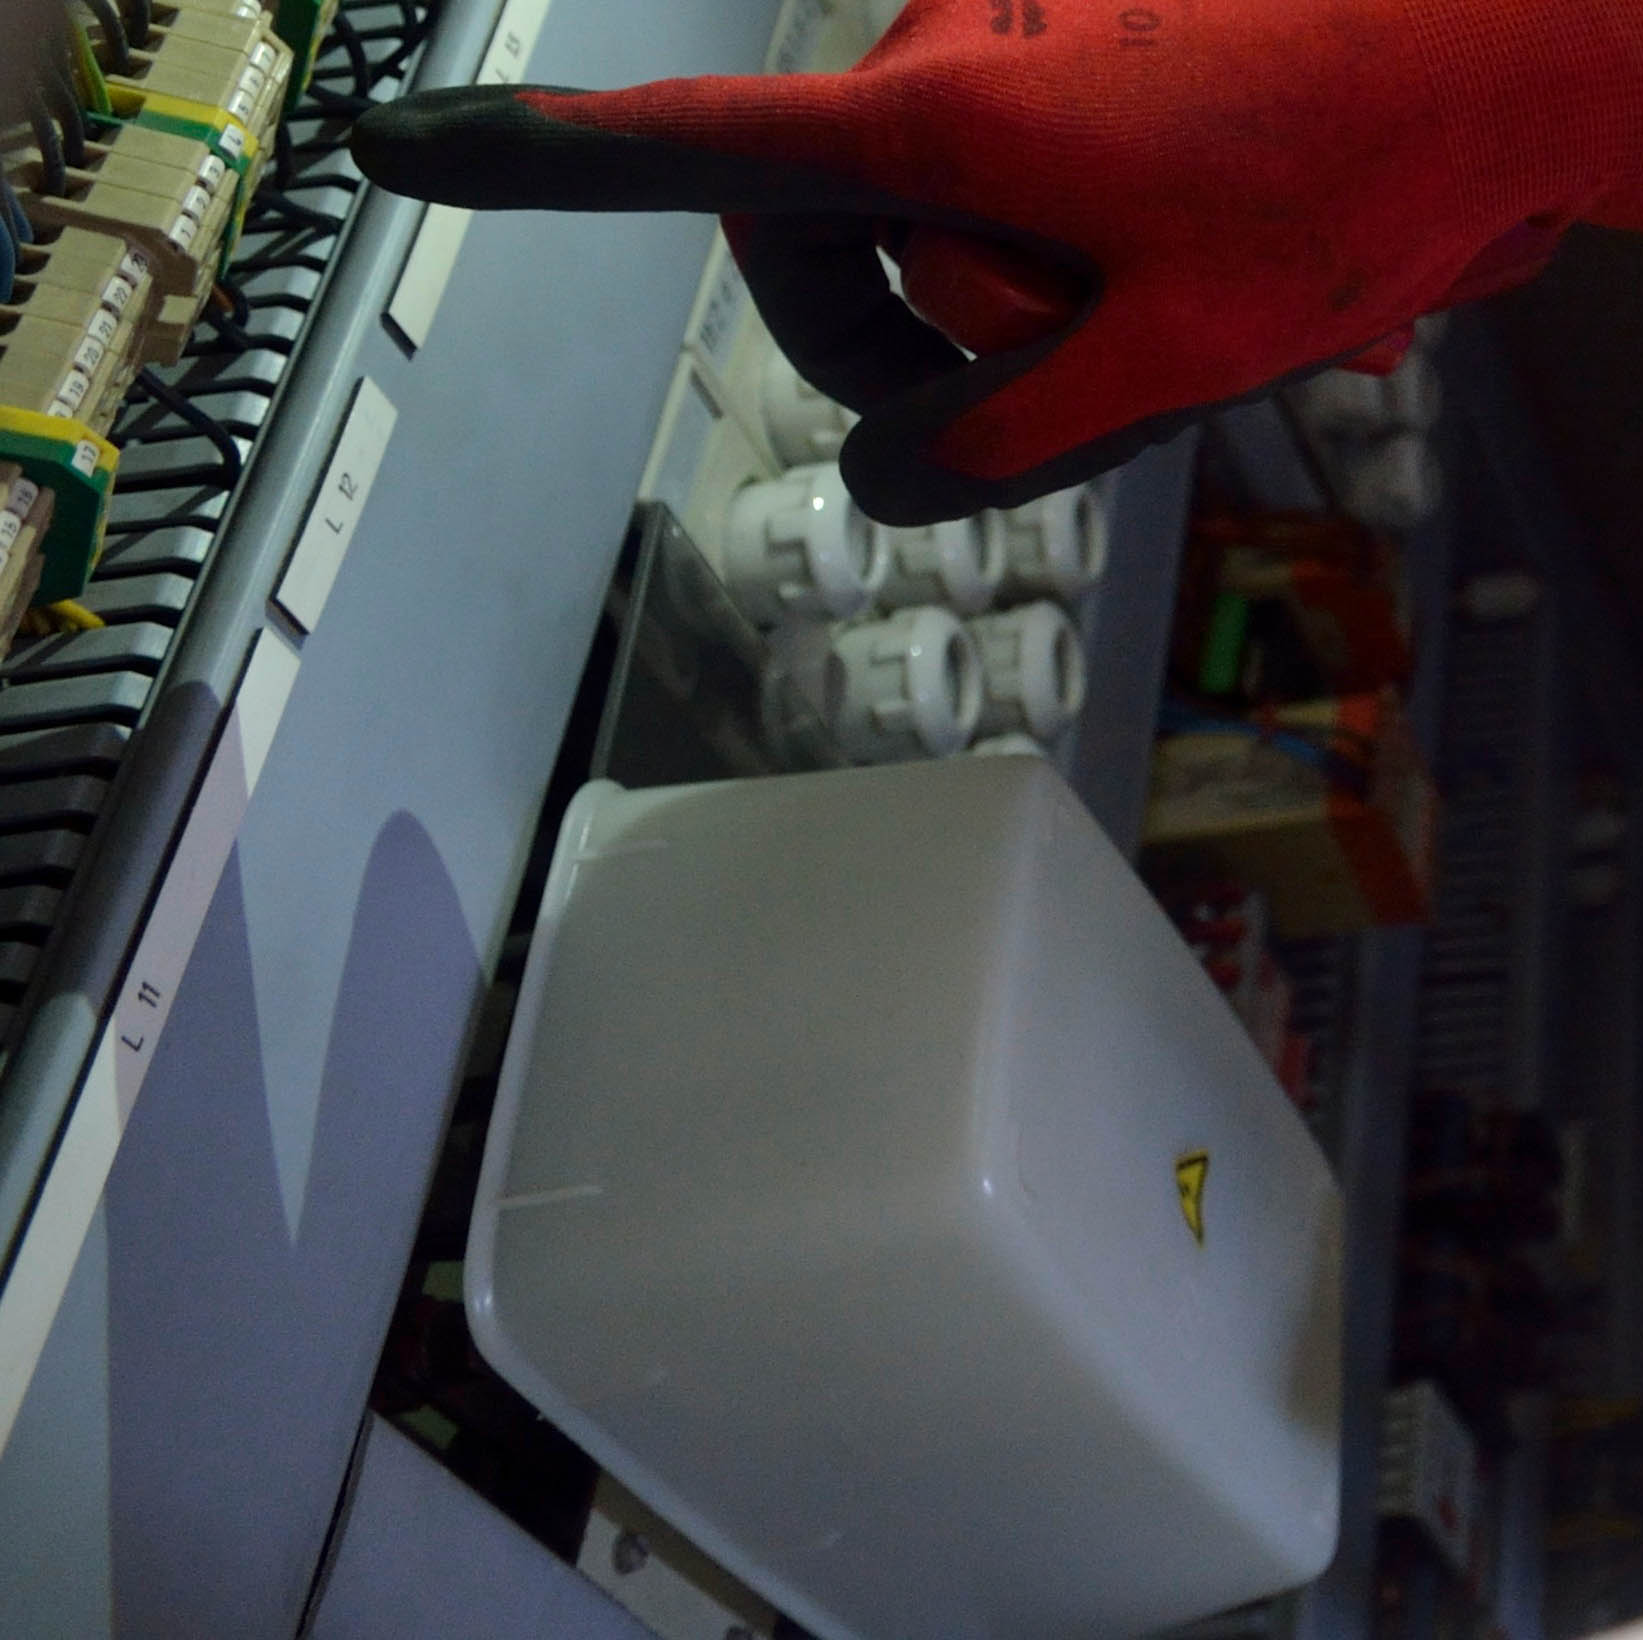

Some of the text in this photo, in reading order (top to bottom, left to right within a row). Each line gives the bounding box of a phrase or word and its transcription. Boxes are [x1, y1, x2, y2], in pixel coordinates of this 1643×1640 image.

[1118, 8, 1163, 49] 10
[325, 517, 344, 535] L
[121, 981, 160, 1052] L 11
